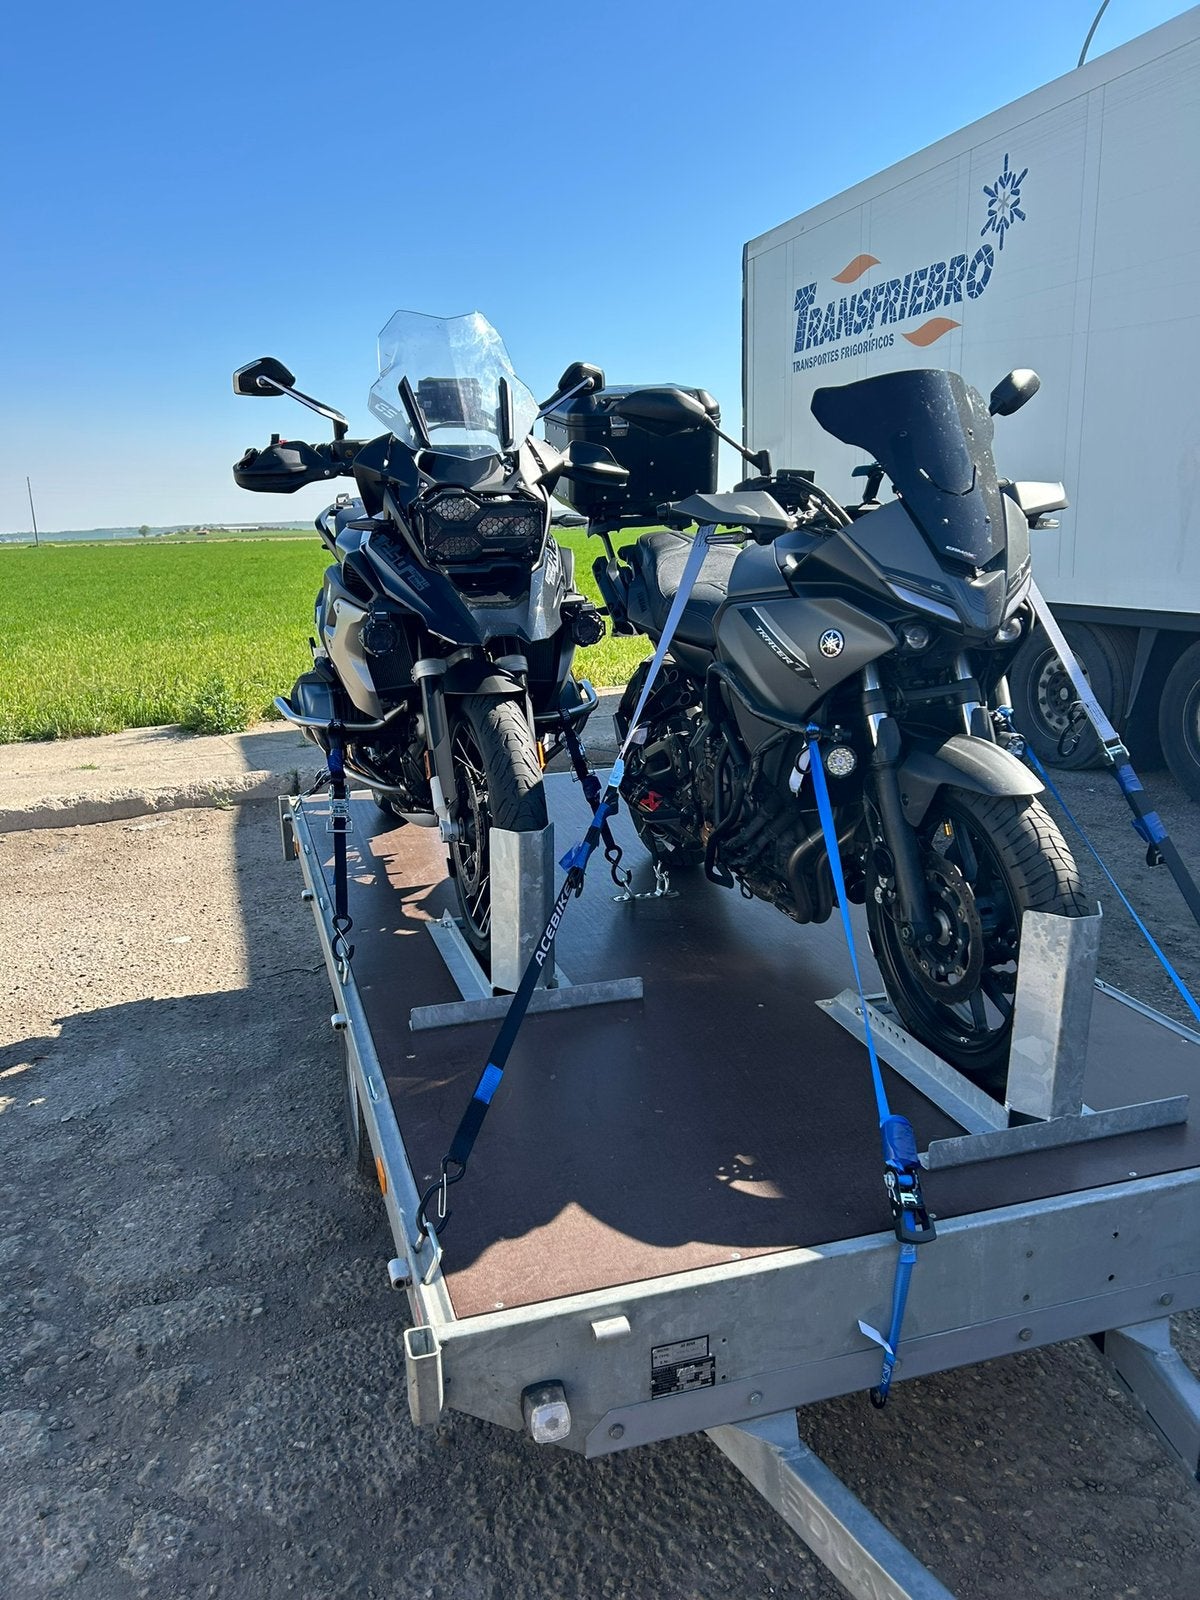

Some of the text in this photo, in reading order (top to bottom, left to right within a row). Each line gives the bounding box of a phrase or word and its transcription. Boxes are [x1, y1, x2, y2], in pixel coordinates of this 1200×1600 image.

[793, 243, 995, 354] TRANSFRIEBRO
[792, 333, 895, 373] TRANSPORTES FRIGORÍFICOS
[755, 625, 795, 665] TRACER
